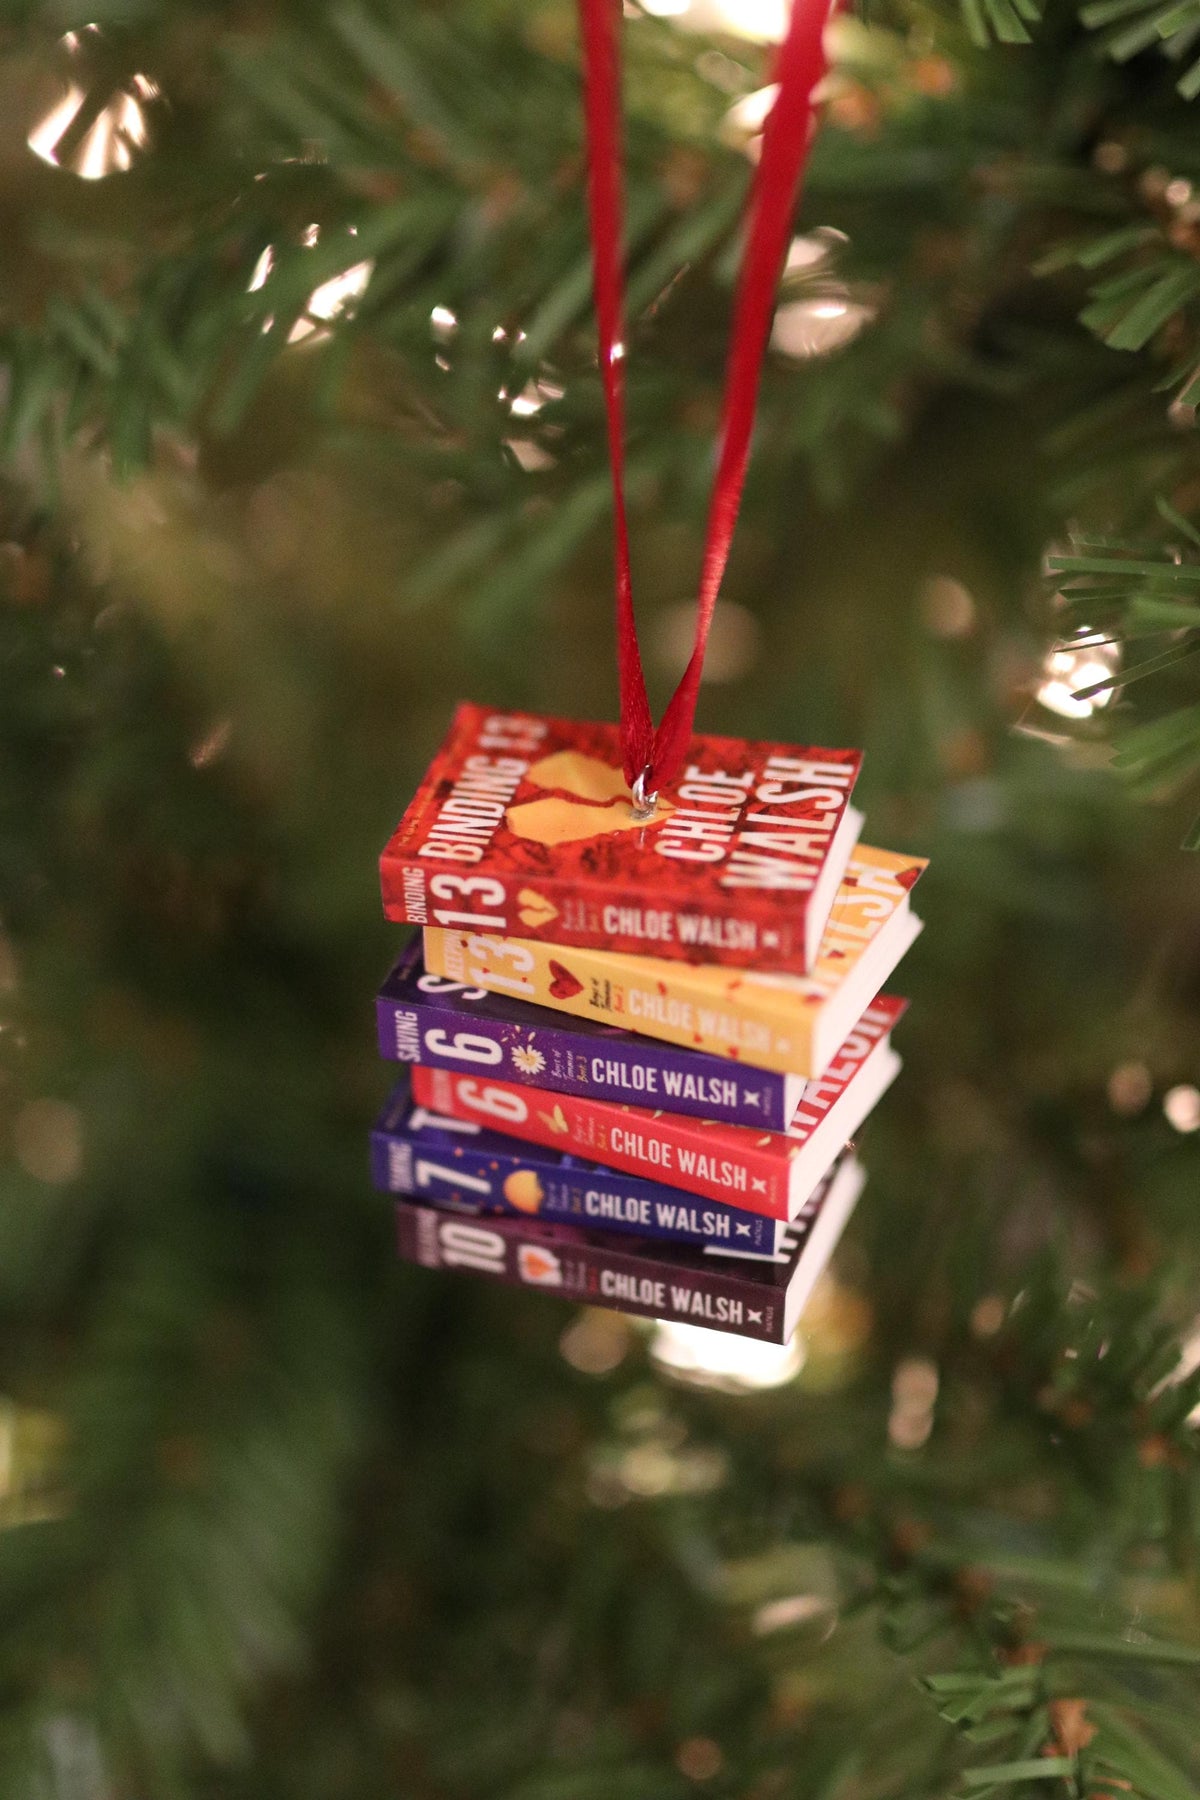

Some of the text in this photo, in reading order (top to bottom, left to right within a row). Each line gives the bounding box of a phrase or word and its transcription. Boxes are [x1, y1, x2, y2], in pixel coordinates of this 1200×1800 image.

[418, 715, 548, 863] BINDING 13
[655, 765, 754, 862] CHLOE
[720, 756, 854, 890] WALSH
[402, 866, 428, 924] BINDING
[430, 874, 506, 928] 13
[602, 904, 674, 942] CHLOE
[676, 911, 758, 950] WALSH
[395, 1010, 422, 1062] SAVING
[425, 1029, 503, 1065] 6
[627, 991, 771, 1050] CHLOE WALSH
[457, 1080, 529, 1124] 6
[591, 1057, 738, 1108] CHLOE WALSH
[415, 1159, 493, 1195] 7
[610, 1127, 672, 1168] CHLOE
[677, 1148, 748, 1192] WALSH
[585, 1190, 651, 1226] CHLOE
[655, 1201, 731, 1238] WALSH
[440, 1222, 506, 1275] 10
[600, 1269, 666, 1308] CHLOE
[671, 1284, 744, 1325] WALSH
